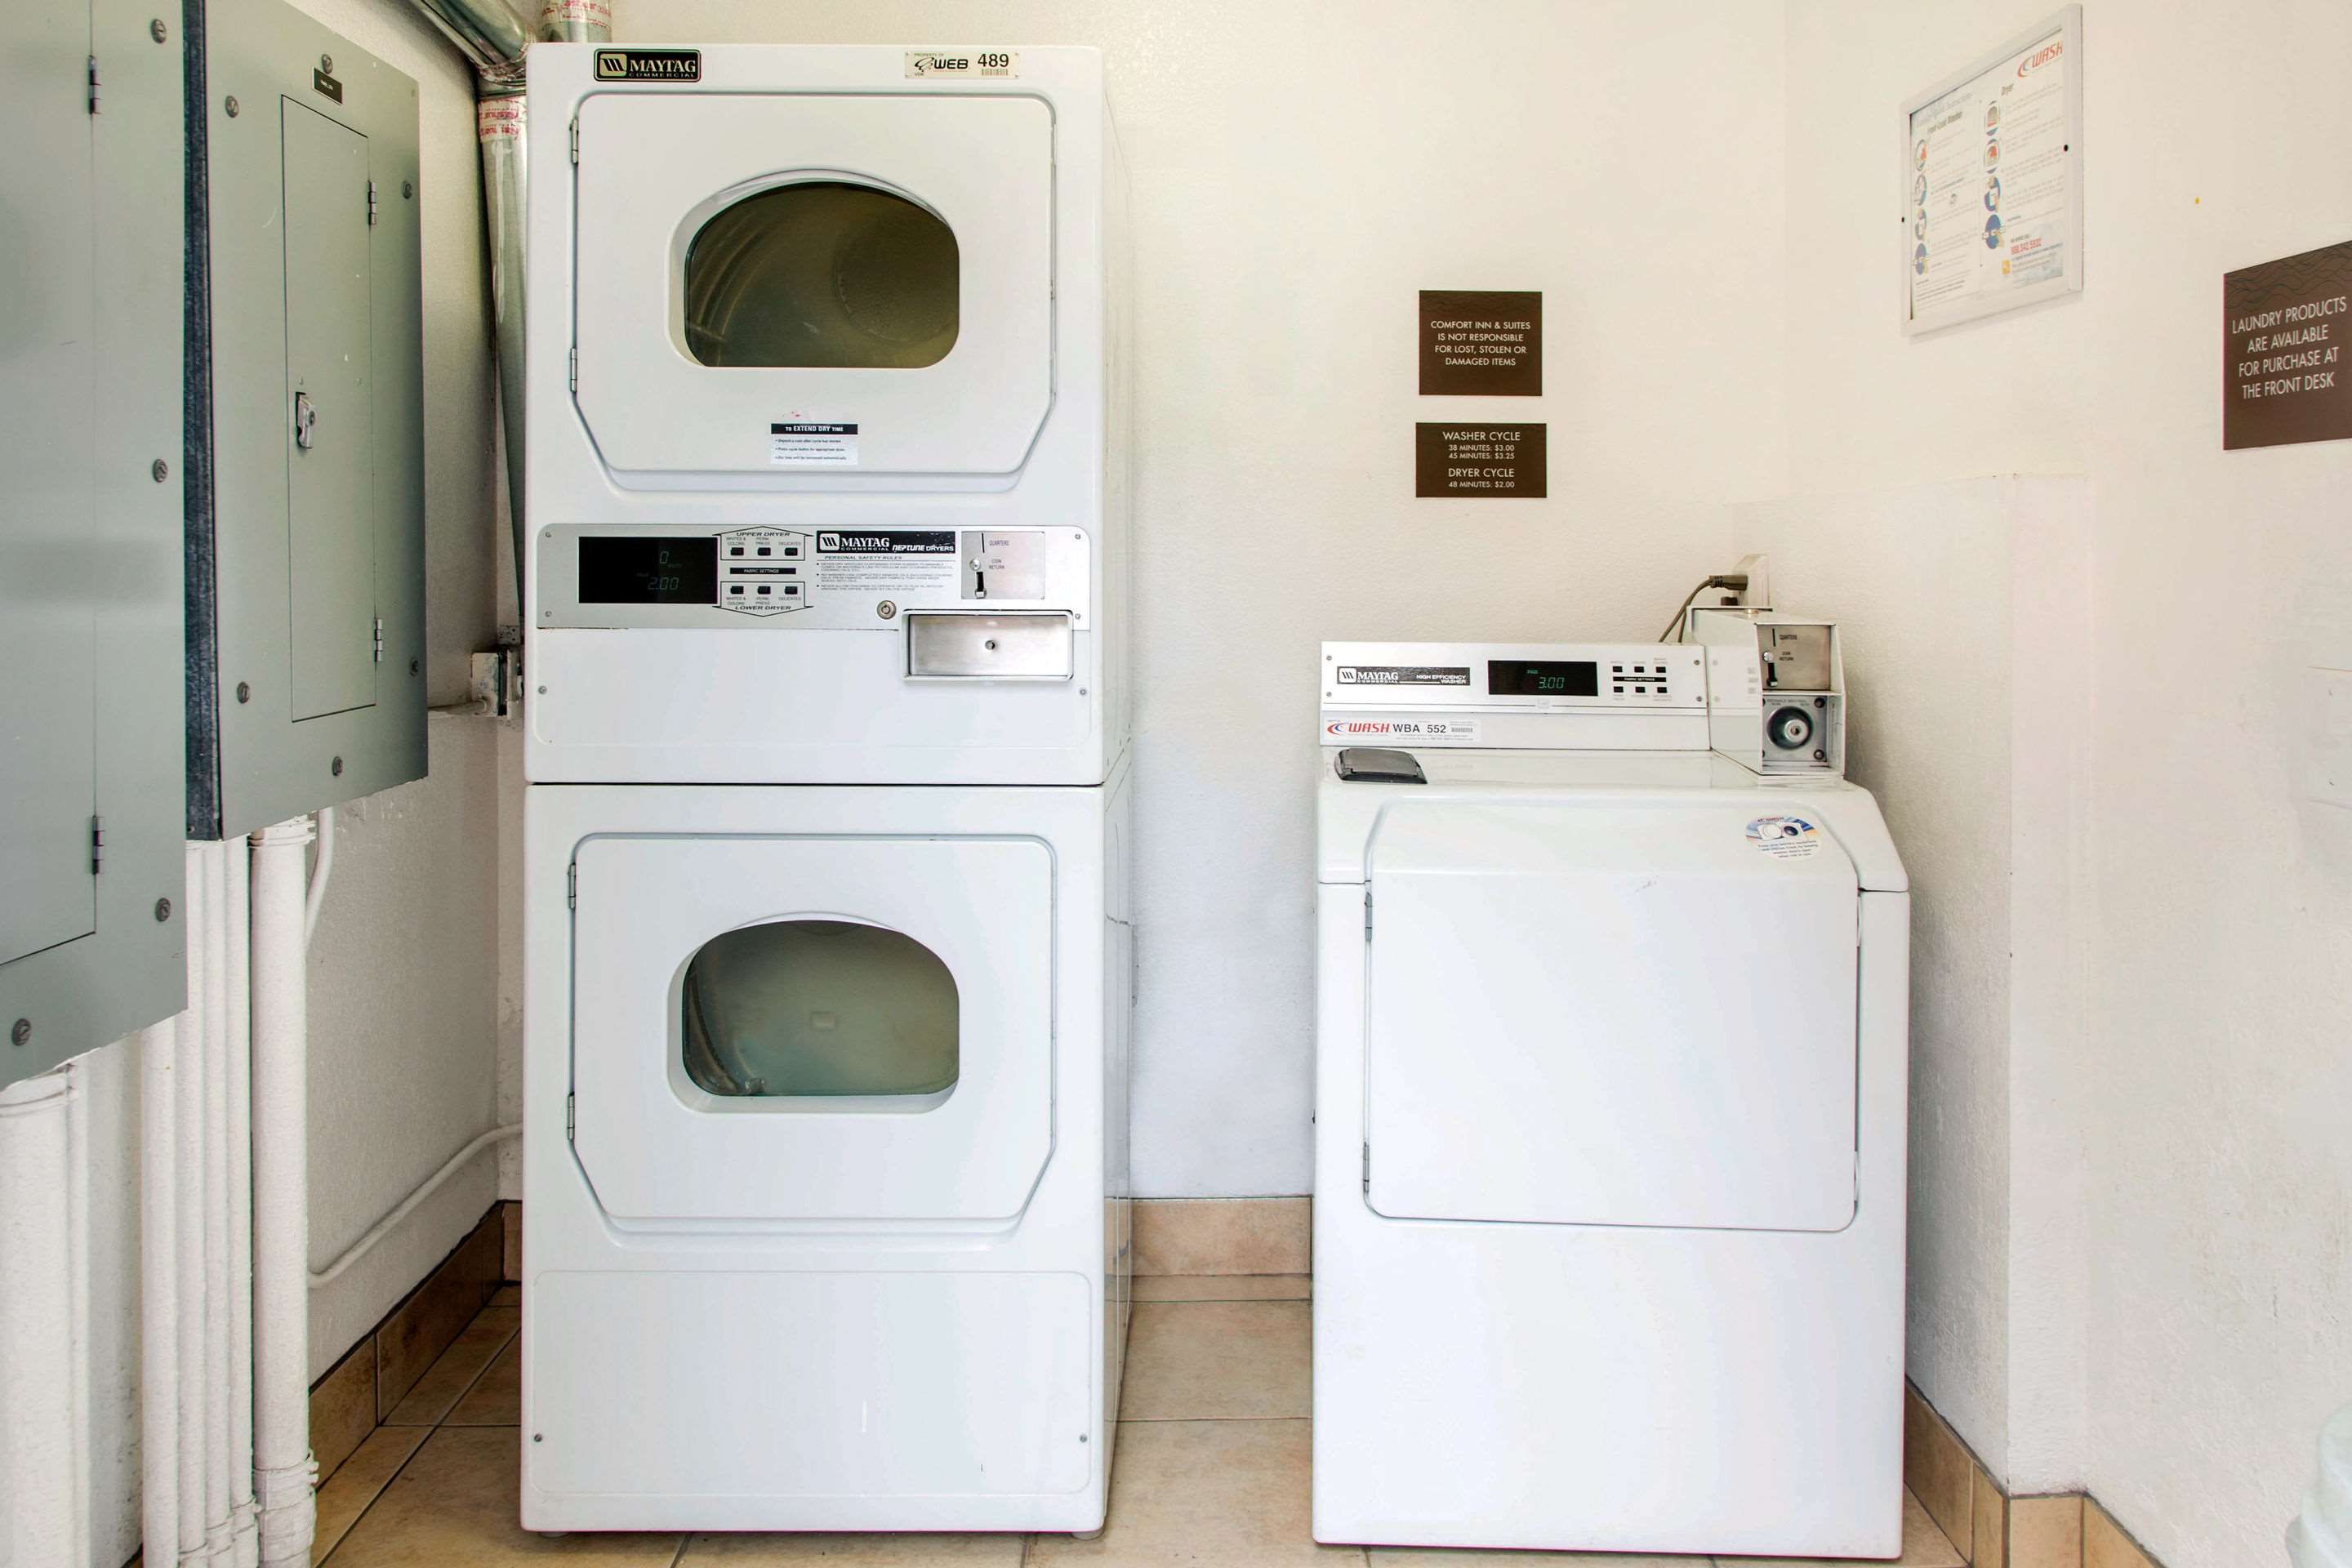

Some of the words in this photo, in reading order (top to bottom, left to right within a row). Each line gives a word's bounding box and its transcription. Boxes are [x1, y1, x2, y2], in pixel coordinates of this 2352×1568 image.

[2032, 39, 2063, 68] WASH
[629, 60, 696, 72] MAYTAG
[933, 59, 969, 69] WEB
[978, 53, 1009, 67] 489
[2232, 310, 2283, 334] LAUNDRY
[2286, 296, 2347, 323] PRODUCTS
[1431, 320, 1473, 330] COMFORT
[1475, 321, 1492, 330] INN
[1494, 322, 1501, 330] &
[1503, 322, 1531, 331] SUITES
[1437, 333, 1446, 341] IS
[1448, 333, 1467, 341] NOT
[1469, 333, 1524, 342] RESPONSIBLE
[2247, 336, 2268, 354] ARE
[2270, 323, 2329, 350] AVAILABLE
[1435, 345, 1453, 354] FOR
[1454, 345, 1477, 355] LOST,
[1479, 345, 1512, 354] STOLEN
[1513, 345, 1527, 354] OR
[1445, 357, 1490, 366] DAMAGED
[1492, 358, 1517, 366] ITEMS
[2238, 362, 2260, 378] FOR
[2263, 350, 2321, 375] PURCHASE
[2323, 346, 2339, 364] AT
[2242, 383, 2261, 399] THE
[2265, 376, 2301, 397] FRONT
[2305, 372, 2336, 391] DESK
[1442, 431, 1486, 441] WASHER
[1489, 431, 1521, 441] CYCLE
[1494, 443, 1515, 452] $3.00
[1448, 468, 1481, 478] DRYER
[1483, 468, 1515, 478] CYCLE
[1459, 480, 1493, 488] MINUTES:
[1494, 480, 1515, 488] $2.00
[840, 537, 889, 547] MAYTAG
[1357, 671, 1398, 680] MAYTAG
[1538, 676, 1565, 688] 3.00
[1348, 723, 1389, 733] WASH
[1392, 724, 1420, 733] WBA
[1427, 724, 1446, 733] 552
